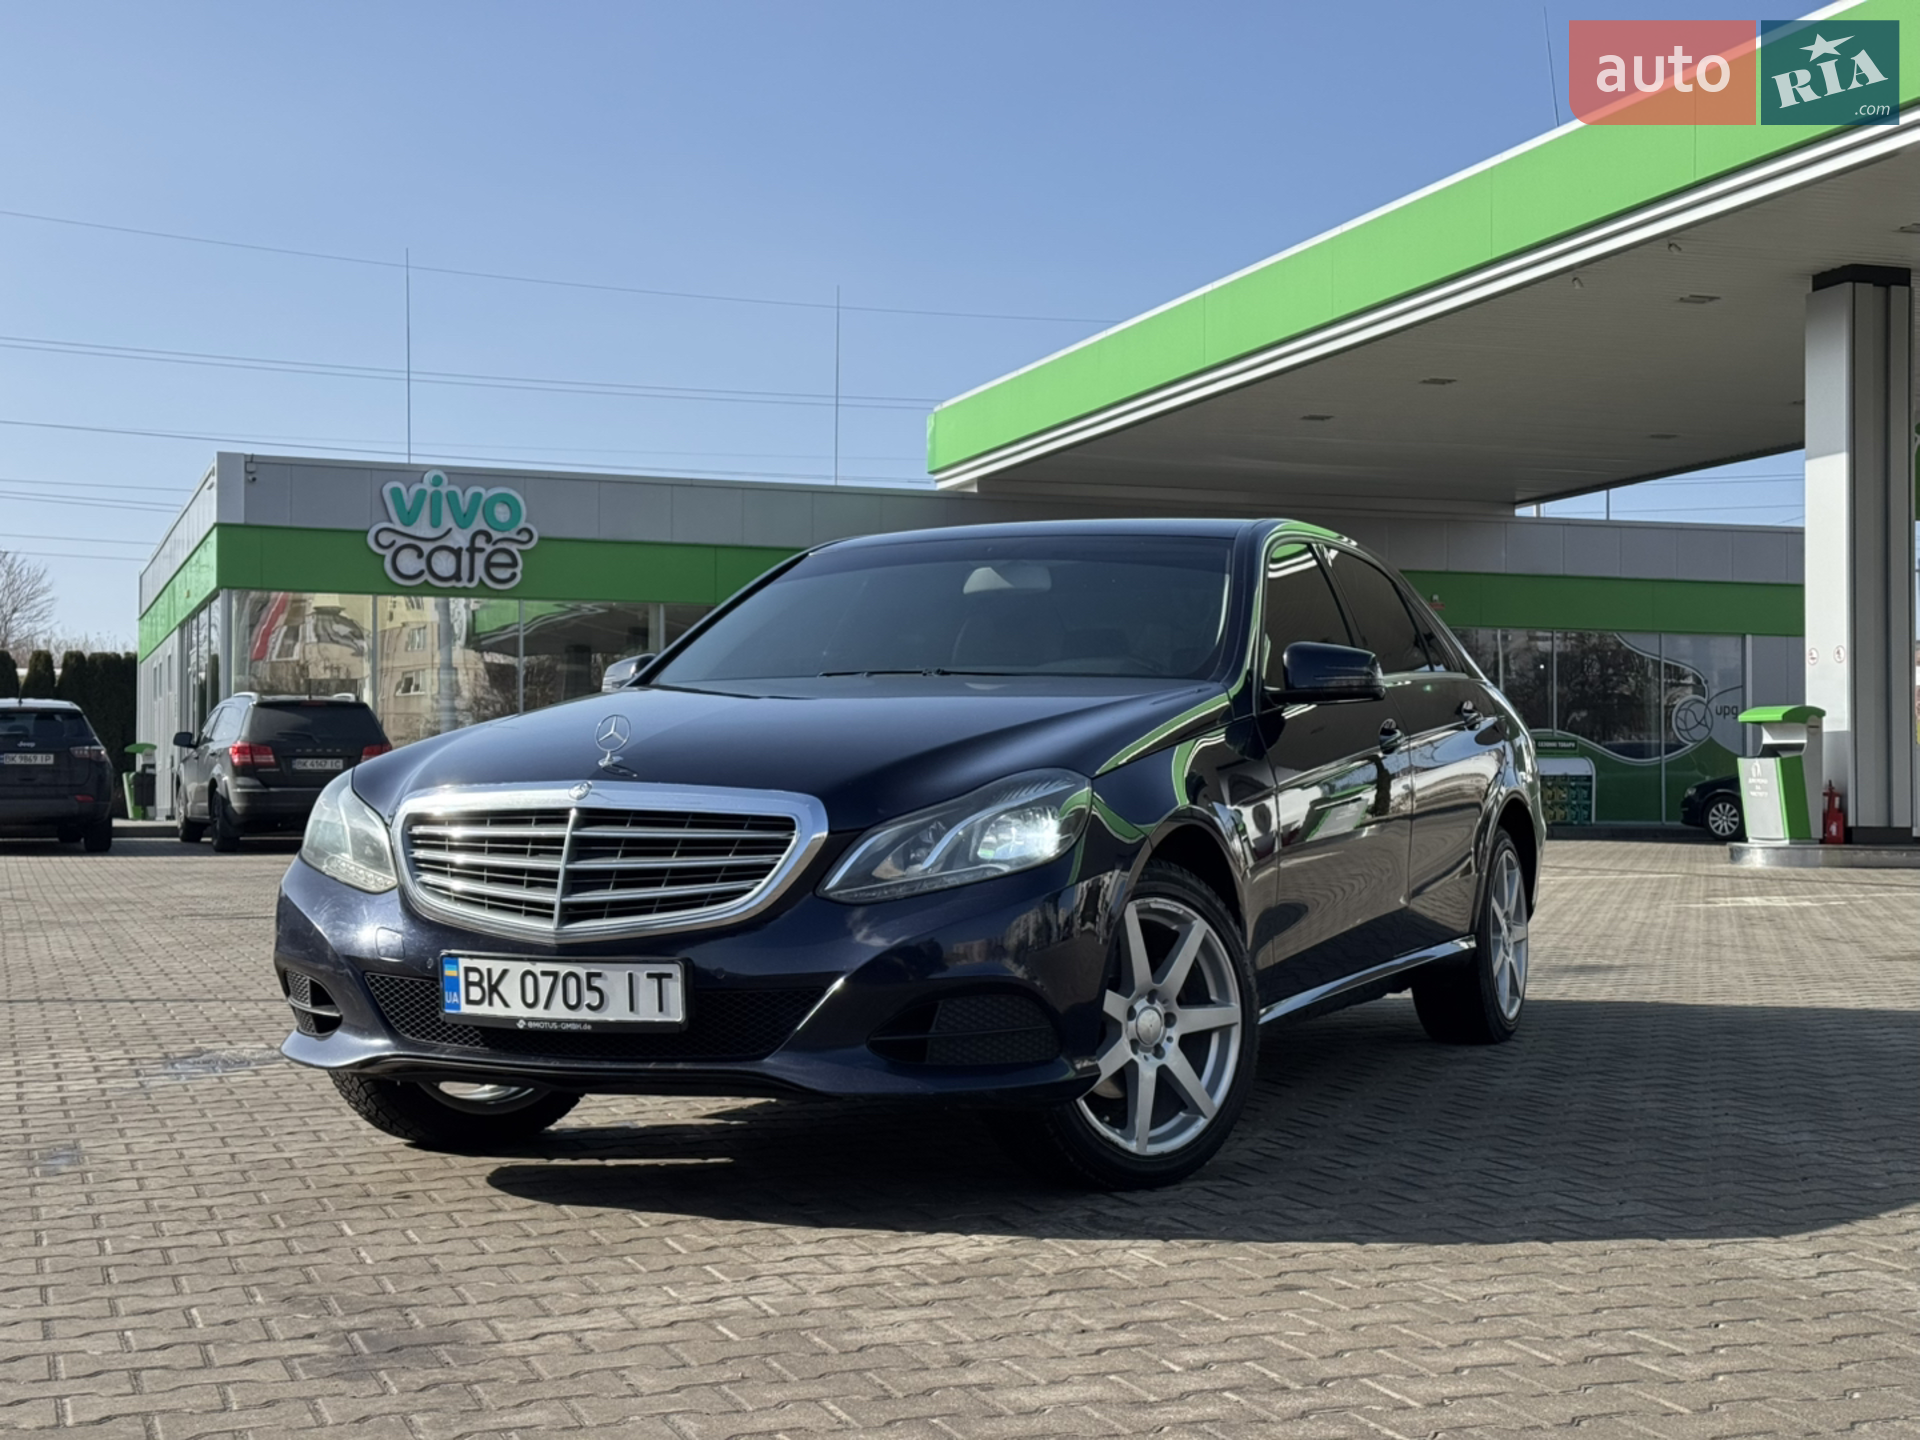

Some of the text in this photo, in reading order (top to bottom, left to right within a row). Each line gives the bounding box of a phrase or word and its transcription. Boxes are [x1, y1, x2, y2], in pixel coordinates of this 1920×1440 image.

[390, 474, 522, 532] vivo
[1715, 705, 1739, 720] upg
[444, 991, 460, 1005] UA
[463, 966, 673, 1013] BK 0705 IT
